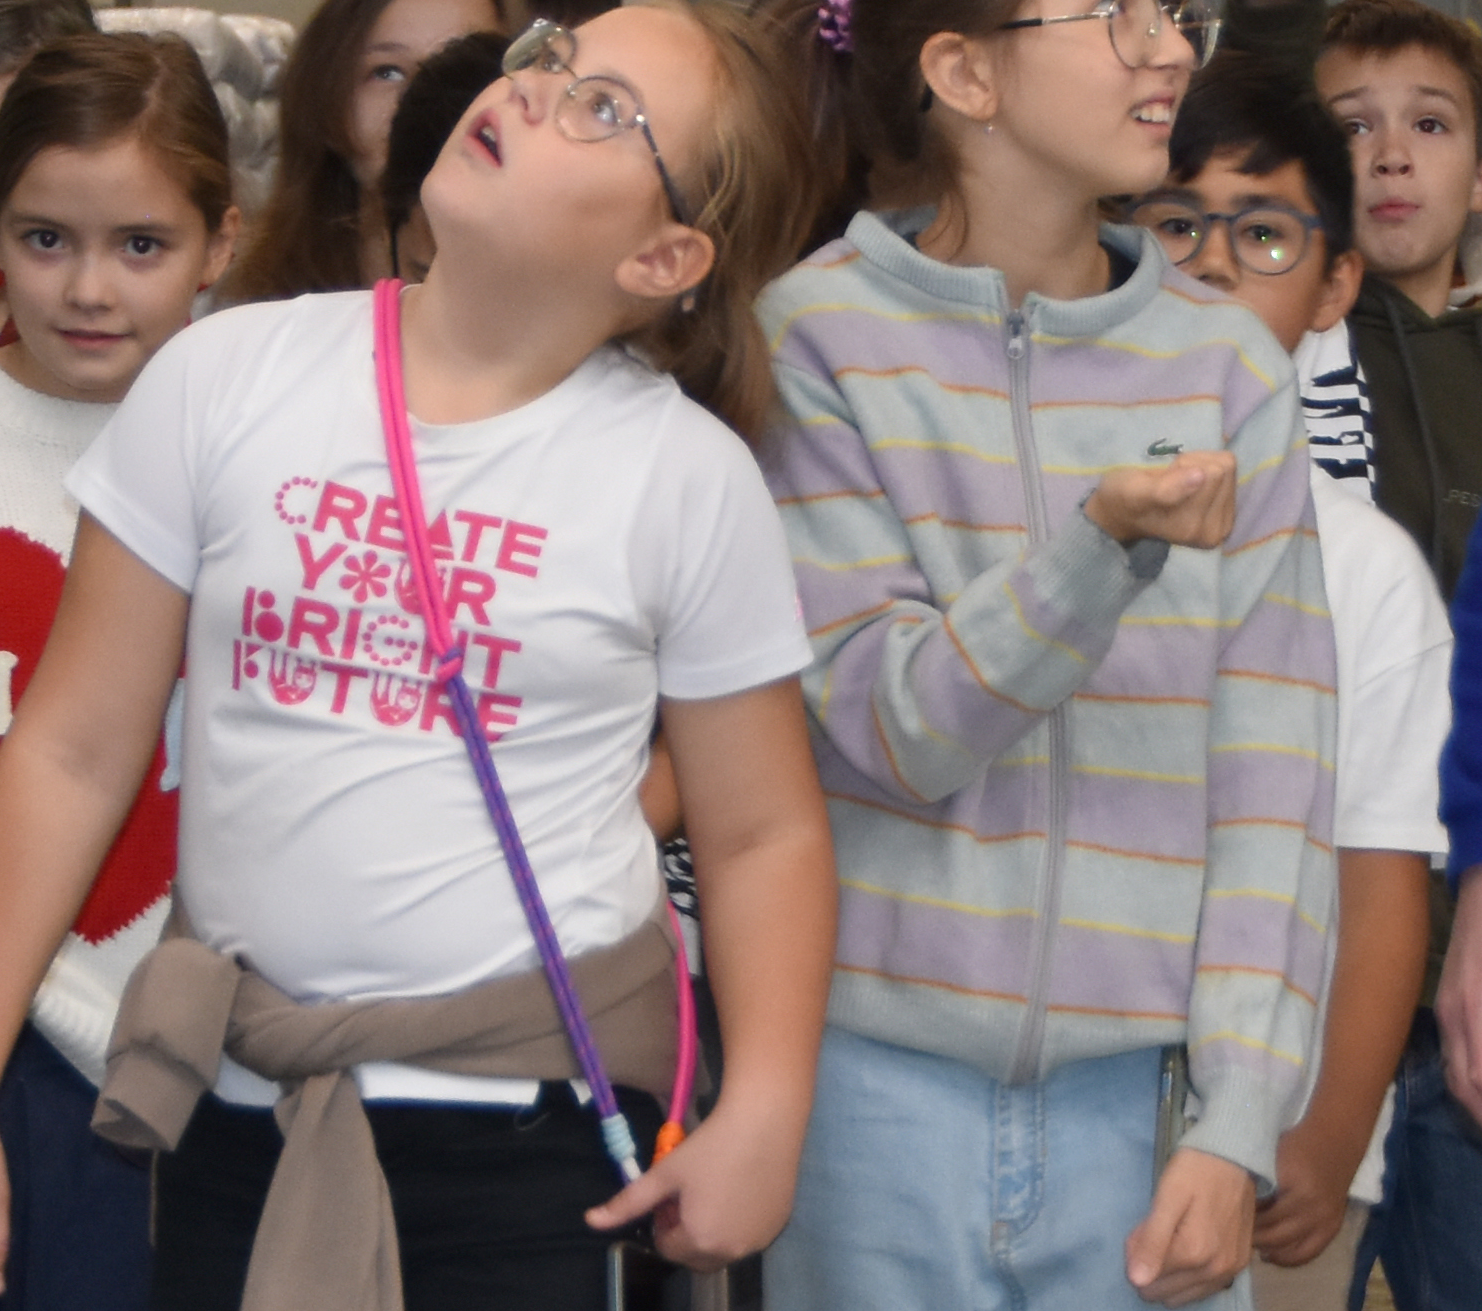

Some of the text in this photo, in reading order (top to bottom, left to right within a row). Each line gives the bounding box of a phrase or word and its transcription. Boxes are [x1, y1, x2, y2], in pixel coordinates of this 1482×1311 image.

[274, 475, 549, 579] CREATE
[241, 585, 523, 690] BRIGHT
[231, 639, 524, 745] FUTURE
